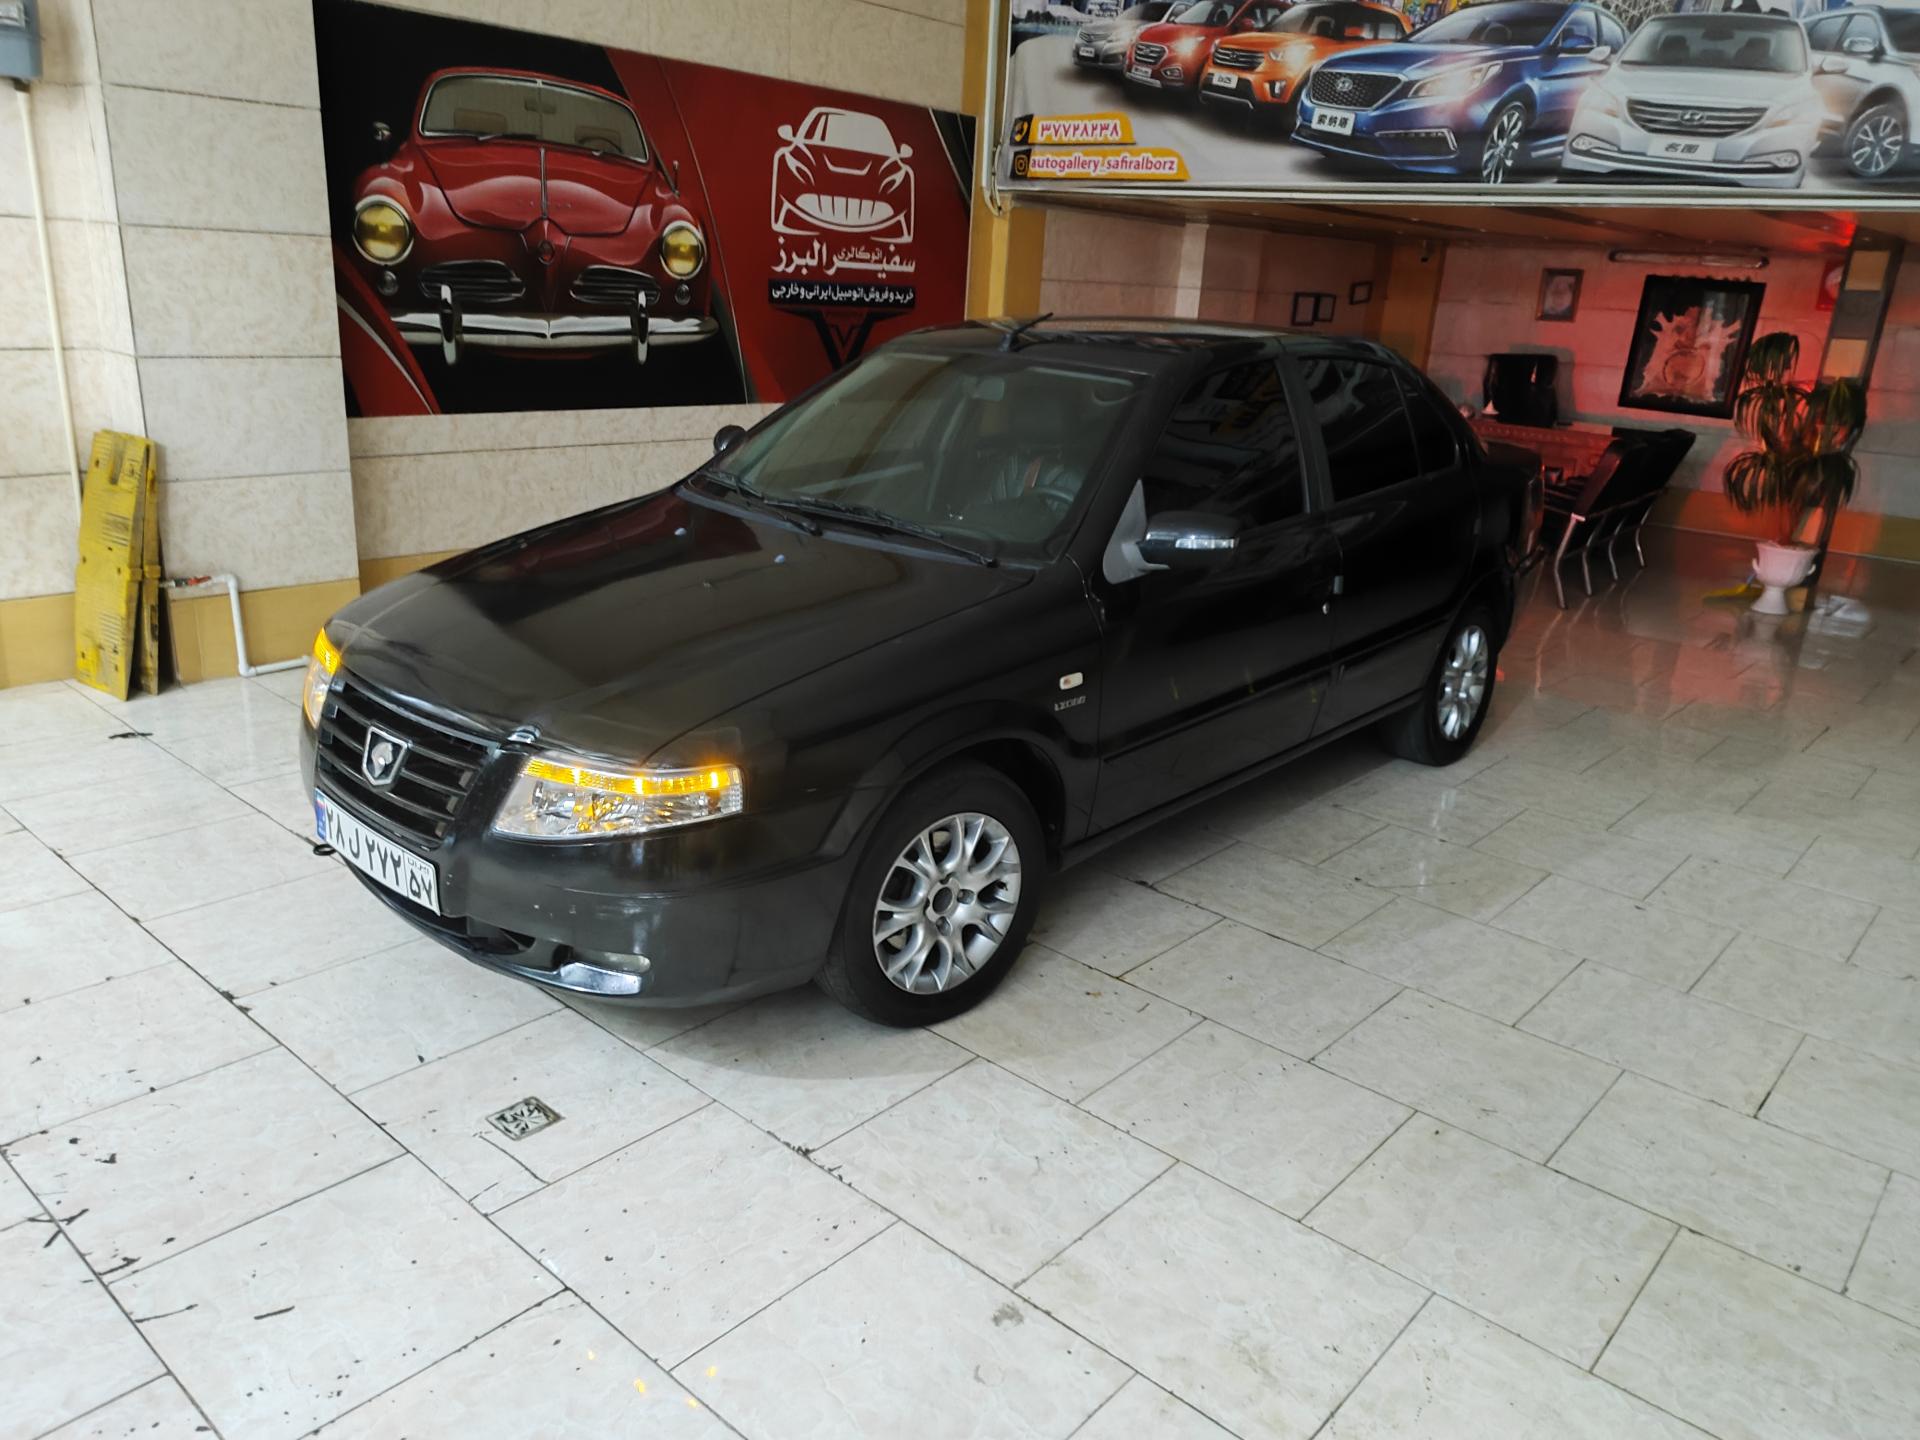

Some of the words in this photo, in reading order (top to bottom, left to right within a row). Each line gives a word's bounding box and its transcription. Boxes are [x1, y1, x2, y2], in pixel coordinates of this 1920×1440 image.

[1040, 122, 1119, 138] ۳۷۷۲۸۲۳۸
[771, 235, 827, 276] البرز
[771, 282, 799, 299] خارجی
[805, 284, 832, 300] ایرانی
[863, 286, 889, 303] فروش
[894, 288, 914, 304] خرید
